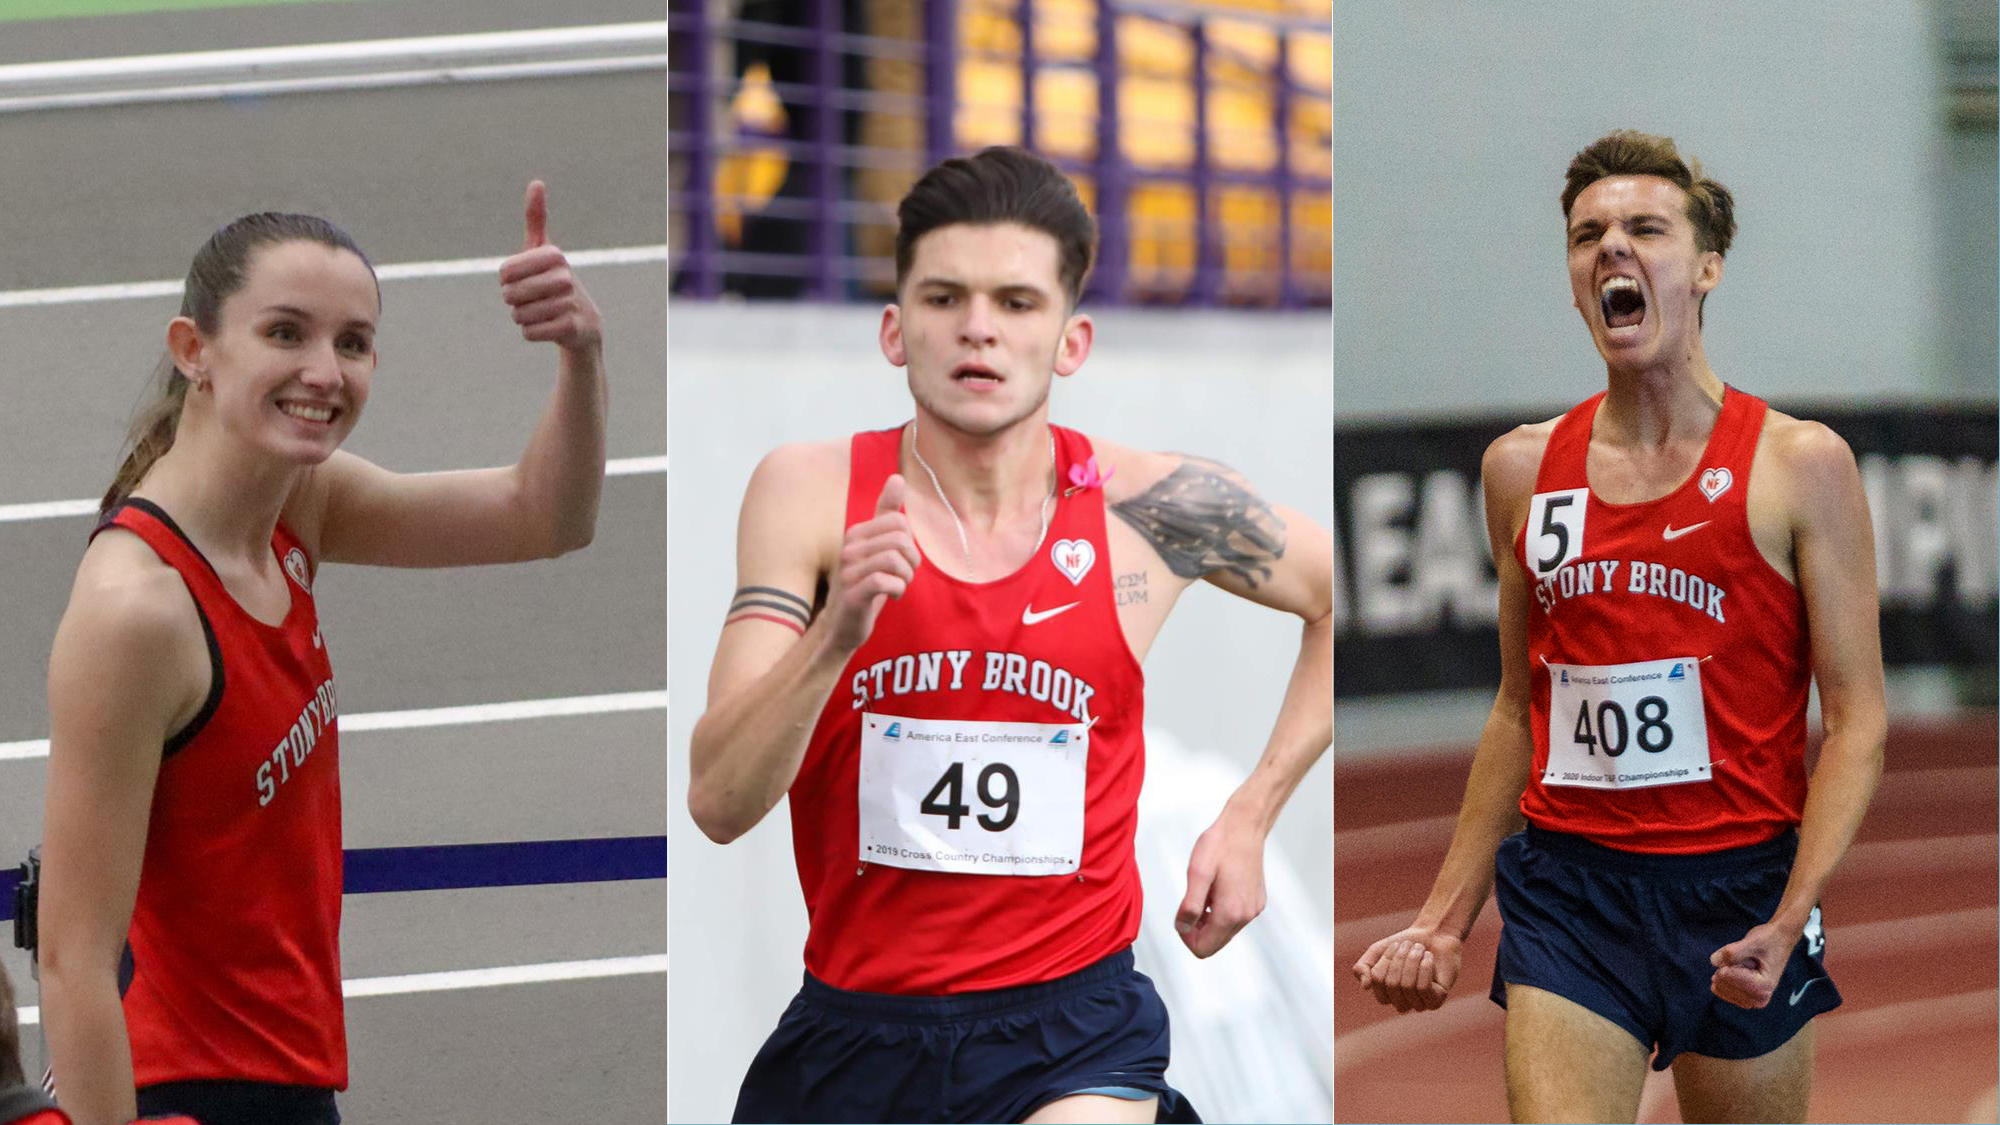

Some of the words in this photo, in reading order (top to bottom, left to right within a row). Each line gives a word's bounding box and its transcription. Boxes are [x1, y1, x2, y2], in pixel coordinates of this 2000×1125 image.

[1705, 477, 1721, 490] NF
[1537, 494, 1575, 573] 5
[1065, 553, 1082, 569] NF
[1535, 560, 1620, 615] STONY
[1627, 560, 1726, 624] BROOK
[852, 650, 973, 710] STONY
[981, 651, 1095, 724] BROOK
[1591, 676, 1609, 685] East
[1610, 672, 1663, 684] Conference
[906, 730, 951, 743] America
[954, 732, 979, 743] East
[981, 732, 1043, 744] Conference
[1573, 695, 1673, 758] 408
[1617, 768, 1689, 783] Championships
[920, 761, 1020, 833] 49
[875, 844, 899, 857] 2019
[900, 849, 932, 861] Cross
[935, 850, 979, 864] Country
[981, 852, 1066, 866] Championships
